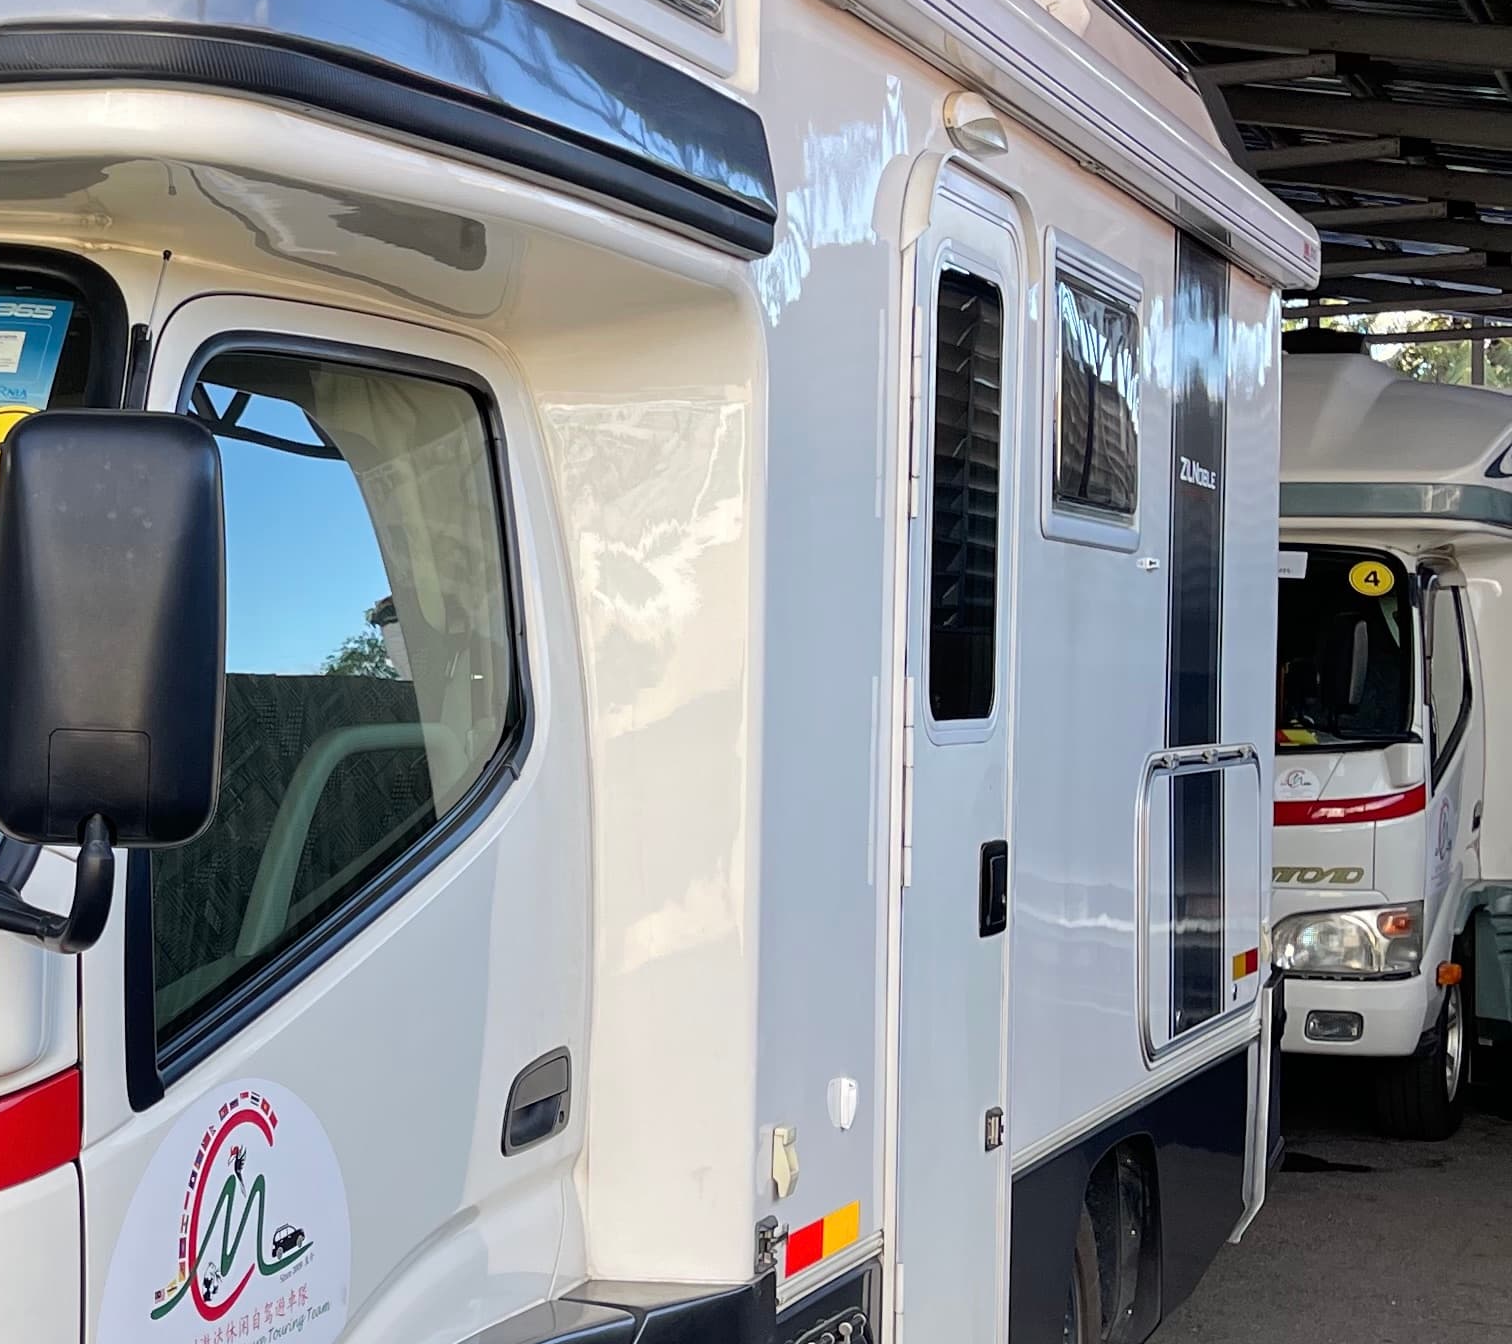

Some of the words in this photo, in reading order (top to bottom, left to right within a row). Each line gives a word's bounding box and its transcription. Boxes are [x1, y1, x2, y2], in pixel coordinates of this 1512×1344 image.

[1363, 570, 1381, 587] 4
[266, 1316, 306, 1344] Touring
[305, 1300, 332, 1322] Team
